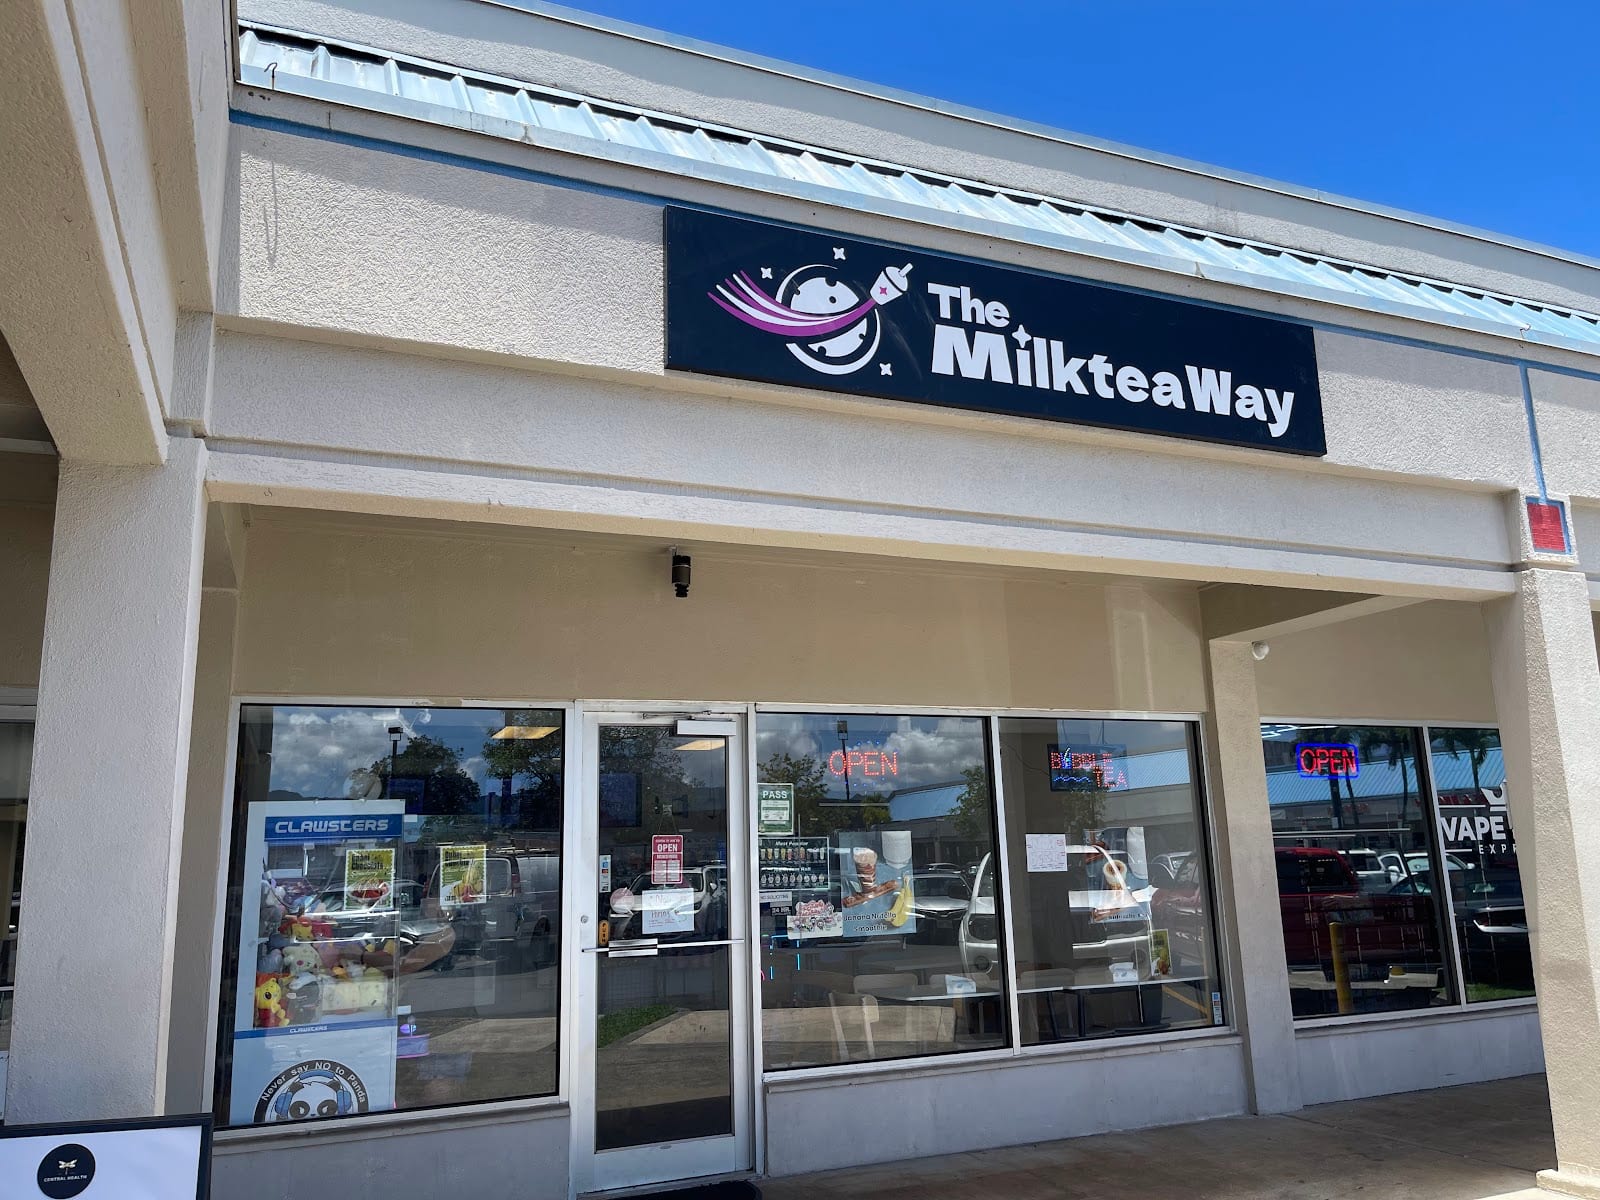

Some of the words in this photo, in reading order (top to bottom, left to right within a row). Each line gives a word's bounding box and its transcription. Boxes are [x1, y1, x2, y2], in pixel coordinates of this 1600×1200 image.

[928, 283, 1010, 328] The
[931, 324, 1295, 437] MilkteaWay
[829, 751, 898, 776] OPEN
[1051, 752, 1114, 769] BUBBLE
[1300, 749, 1357, 773] OPEN
[1093, 771, 1128, 788] TEA
[762, 790, 788, 799] PASS
[275, 819, 389, 833] CLAWSTERS
[1440, 816, 1507, 841] VAPE
[657, 843, 678, 852] OPEN
[261, 1075, 287, 1101] Never
[290, 1064, 309, 1077] say
[315, 1062, 331, 1070] NO
[335, 1066, 345, 1076] to
[347, 1074, 366, 1103] Panda
